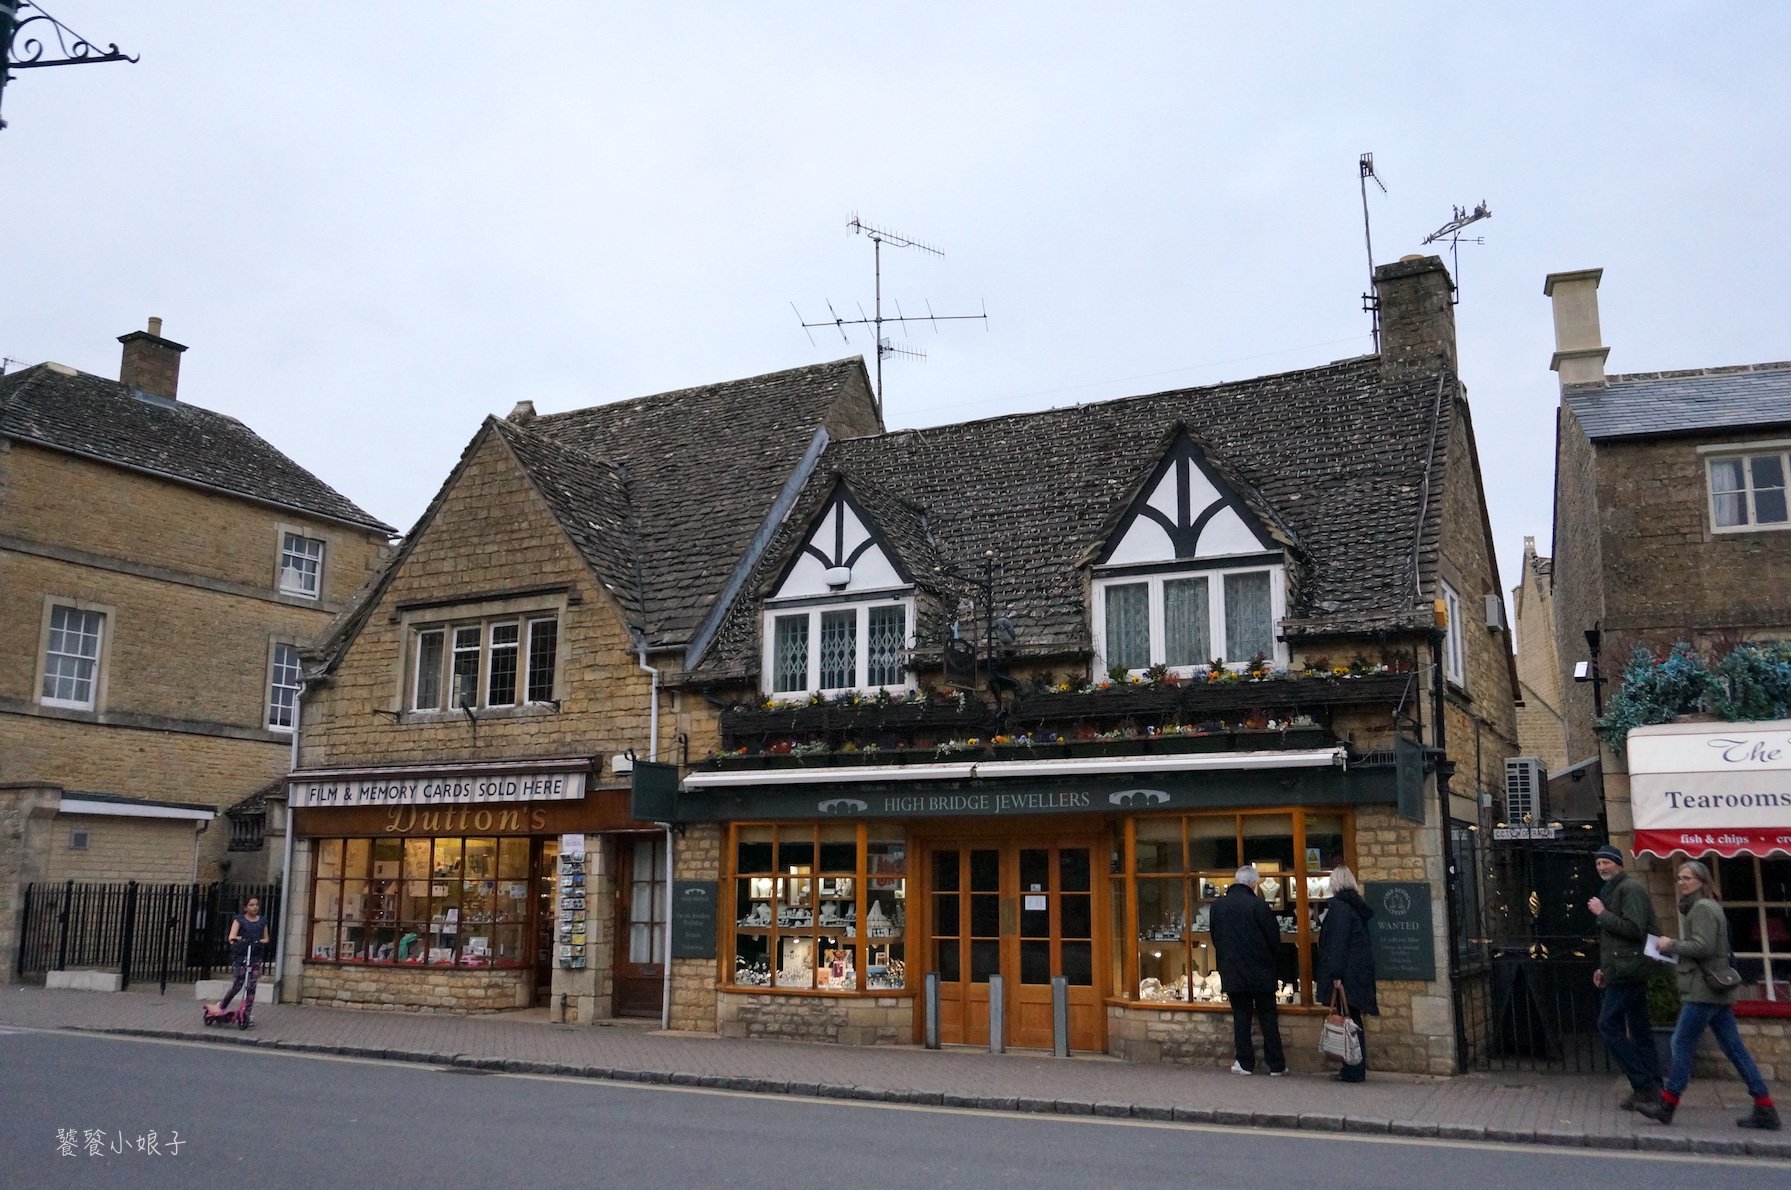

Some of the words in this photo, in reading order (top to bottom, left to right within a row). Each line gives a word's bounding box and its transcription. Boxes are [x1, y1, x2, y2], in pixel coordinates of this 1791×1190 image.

[1707, 738, 1782, 763] The
[310, 788, 338, 802] FILM
[344, 787, 353, 801] &
[359, 785, 418, 800] MEMORY
[423, 783, 470, 799] CARDS
[479, 781, 517, 797] SOLD
[523, 780, 562, 796] HERE
[1665, 791, 1791, 809] Tearooms
[884, 797, 924, 812] HIGH
[929, 795, 989, 811] BRIDGE
[994, 792, 1090, 814] JEWELLERS
[386, 805, 546, 833] Dutton's
[1680, 834, 1703, 844] fish
[1705, 834, 1715, 844] &
[1718, 834, 1750, 845] chips
[1377, 921, 1420, 930] WANTED
